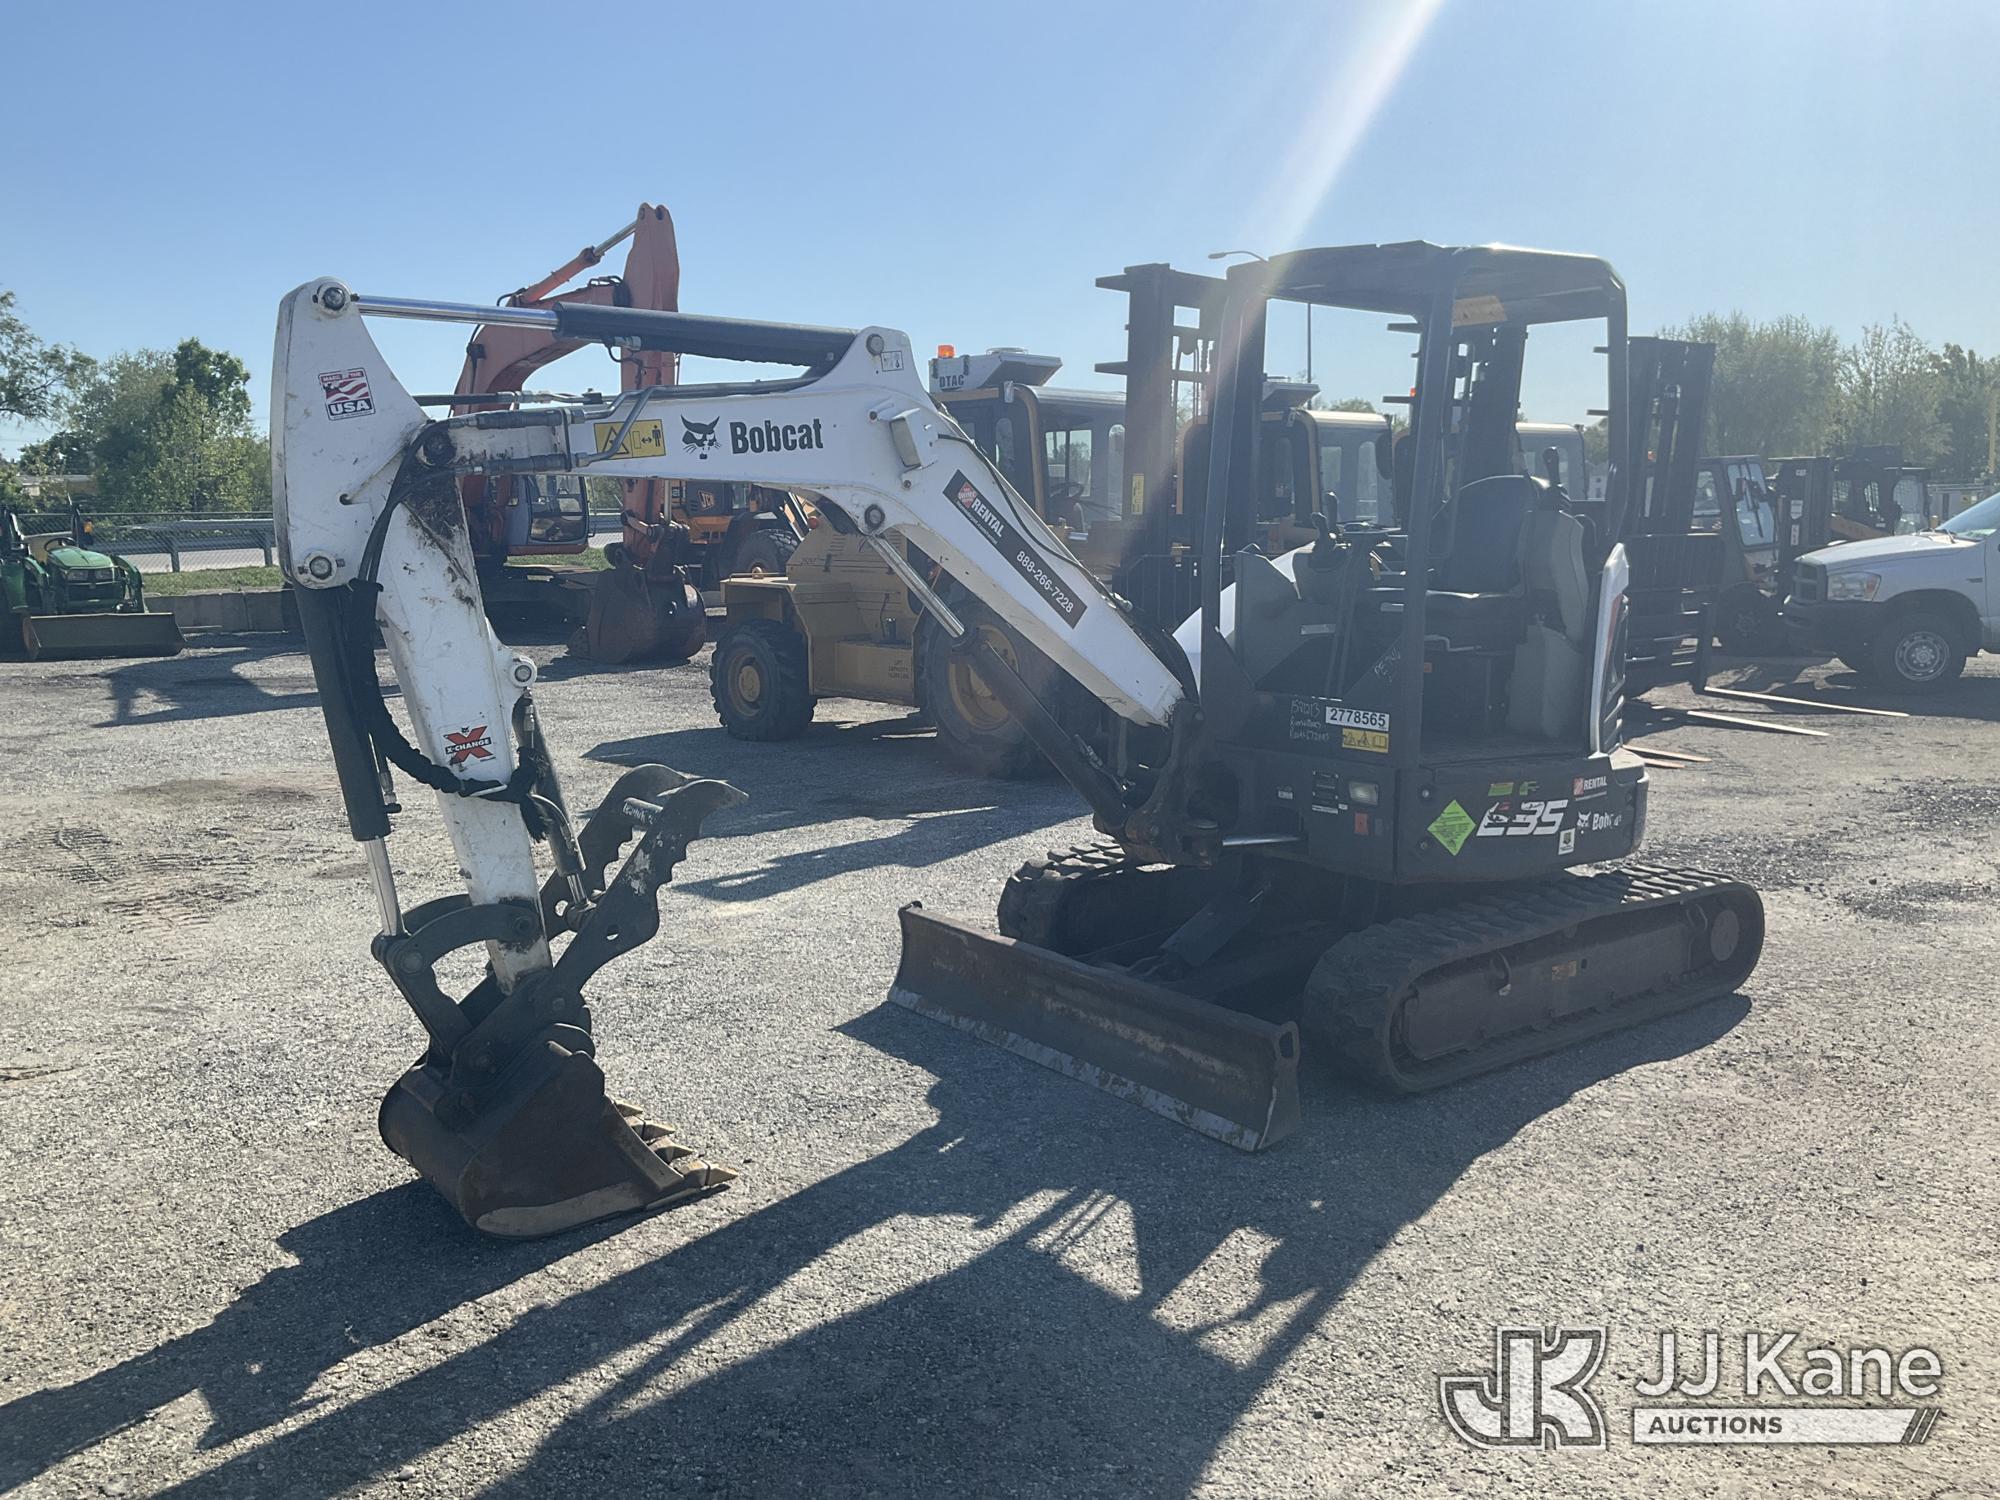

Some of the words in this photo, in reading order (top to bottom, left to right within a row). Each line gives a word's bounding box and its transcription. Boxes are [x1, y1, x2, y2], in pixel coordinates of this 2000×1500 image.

[939, 374, 965, 388] DTAC
[330, 400, 370, 415] USA
[729, 418, 824, 454] Bobcat
[971, 498, 1007, 538] RENTAL
[1016, 550, 1074, 613] 888-266-7228
[1330, 708, 1387, 727] 2778565
[446, 738, 490, 753] X-CHANGE
[1583, 775, 1608, 790] RENTAL
